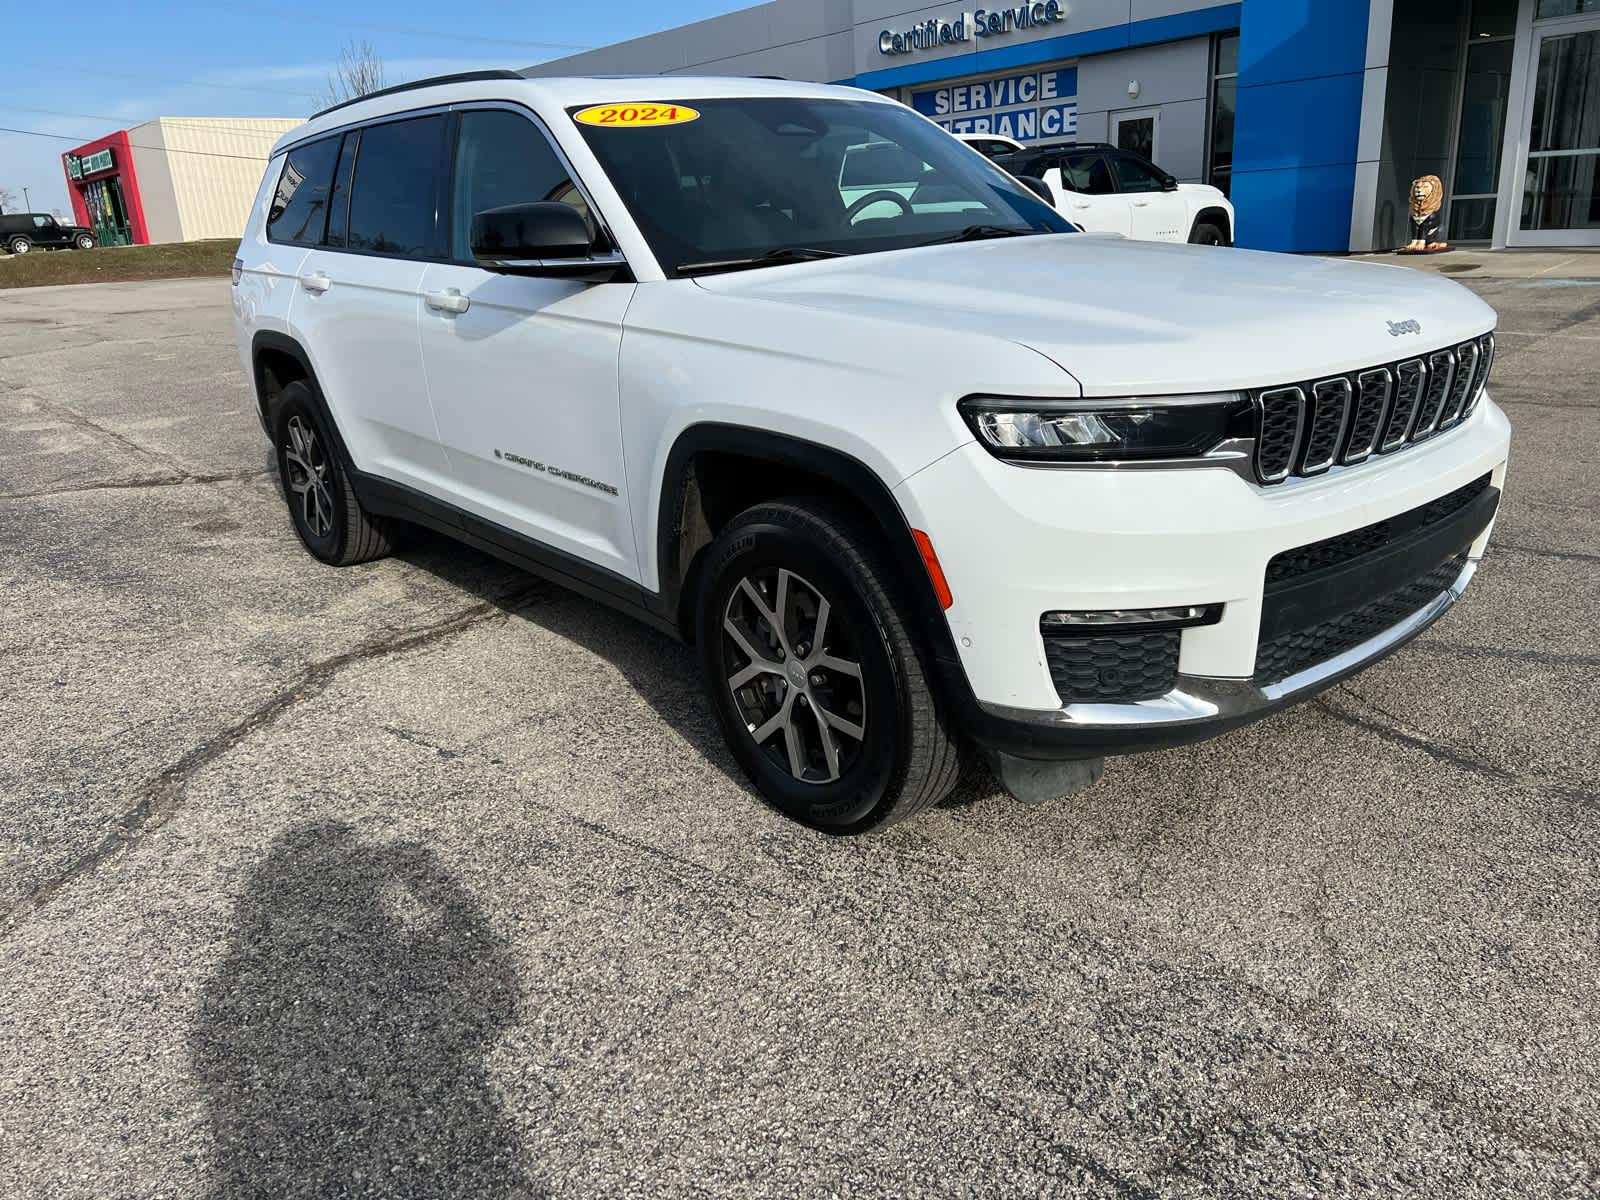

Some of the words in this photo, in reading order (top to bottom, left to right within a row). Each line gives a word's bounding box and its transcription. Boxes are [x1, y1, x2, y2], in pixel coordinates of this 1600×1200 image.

[879, 12, 967, 55] Certified
[974, 0, 1059, 37] Service
[935, 72, 1058, 115] SERVICE
[599, 107, 680, 123] 2024
[943, 106, 1078, 139] TRANCE
[1386, 319, 1421, 337] Jeep
